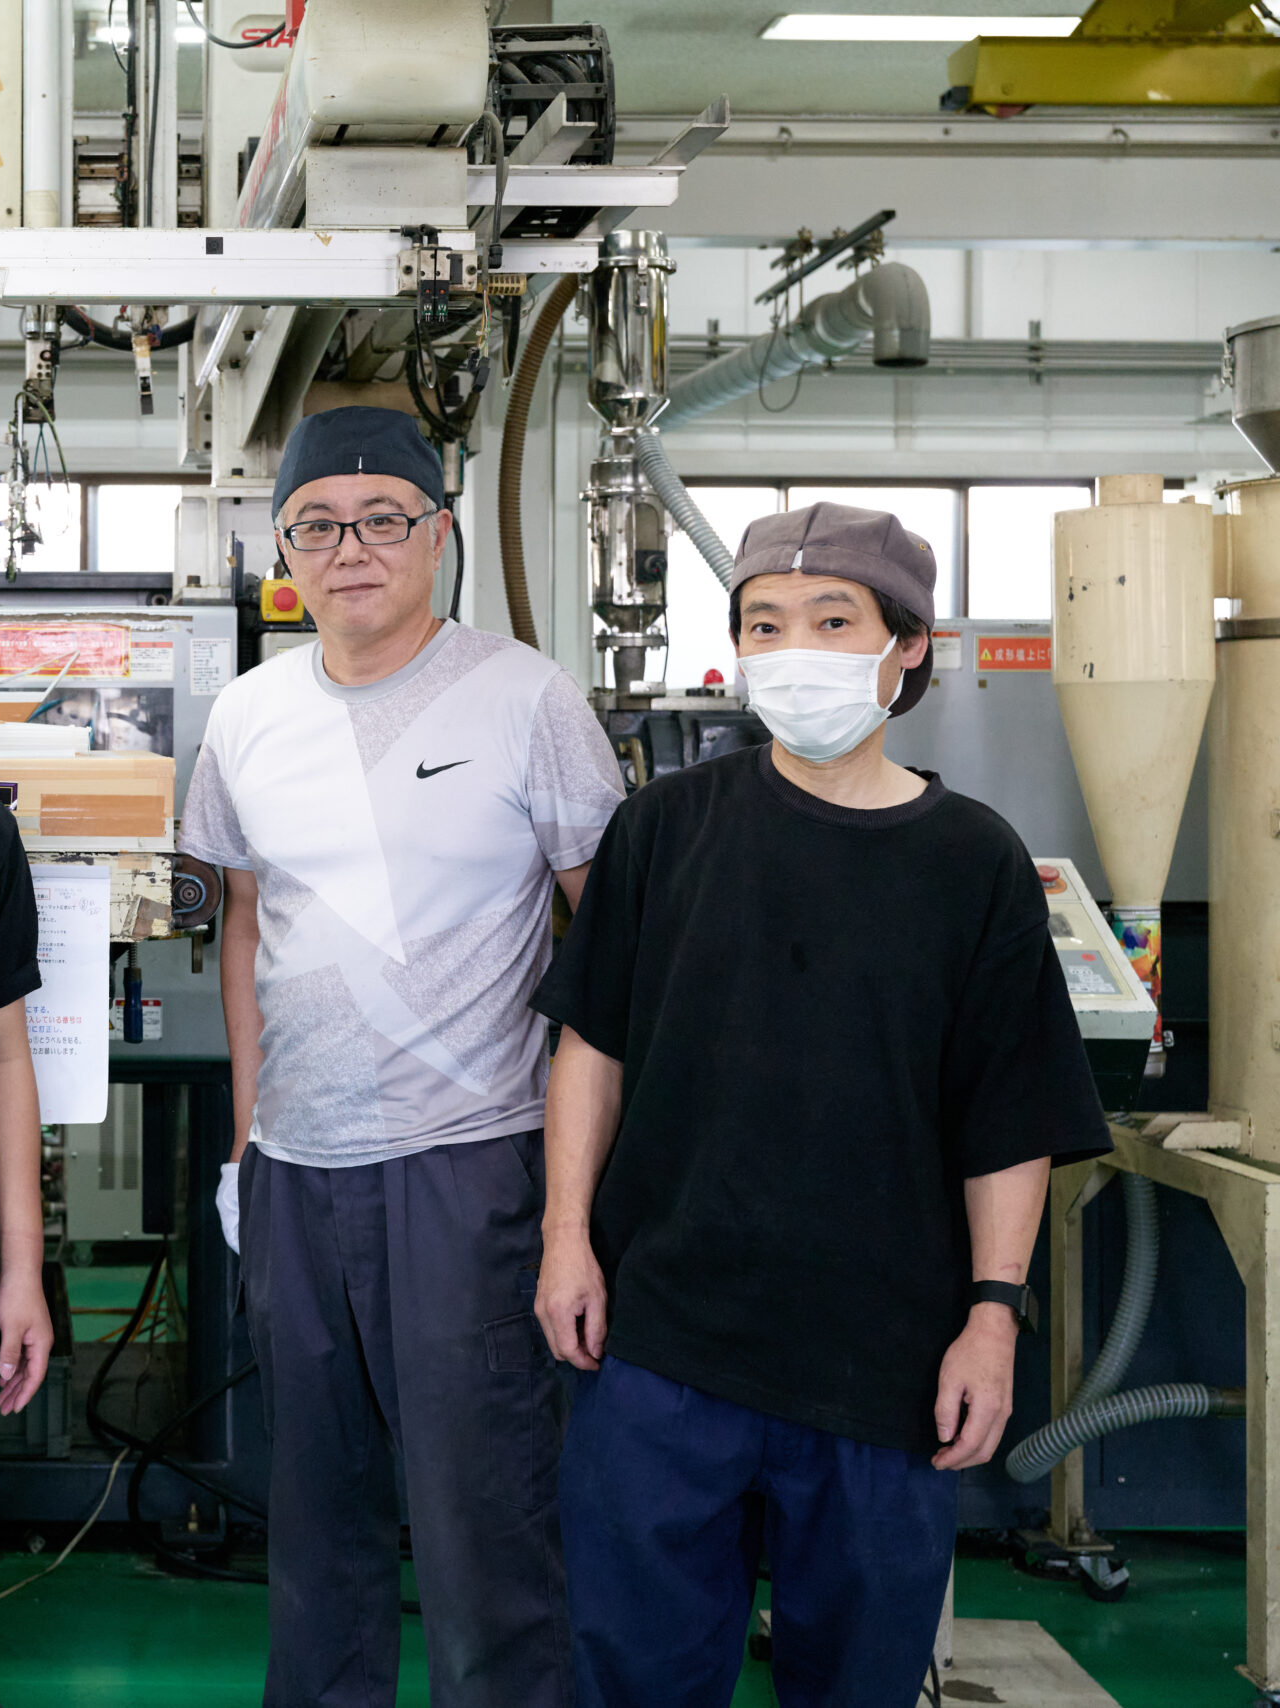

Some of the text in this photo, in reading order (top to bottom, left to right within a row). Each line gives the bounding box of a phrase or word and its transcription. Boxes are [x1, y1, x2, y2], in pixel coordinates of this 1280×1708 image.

[25, 1016, 83, 1024] 入している番号は
